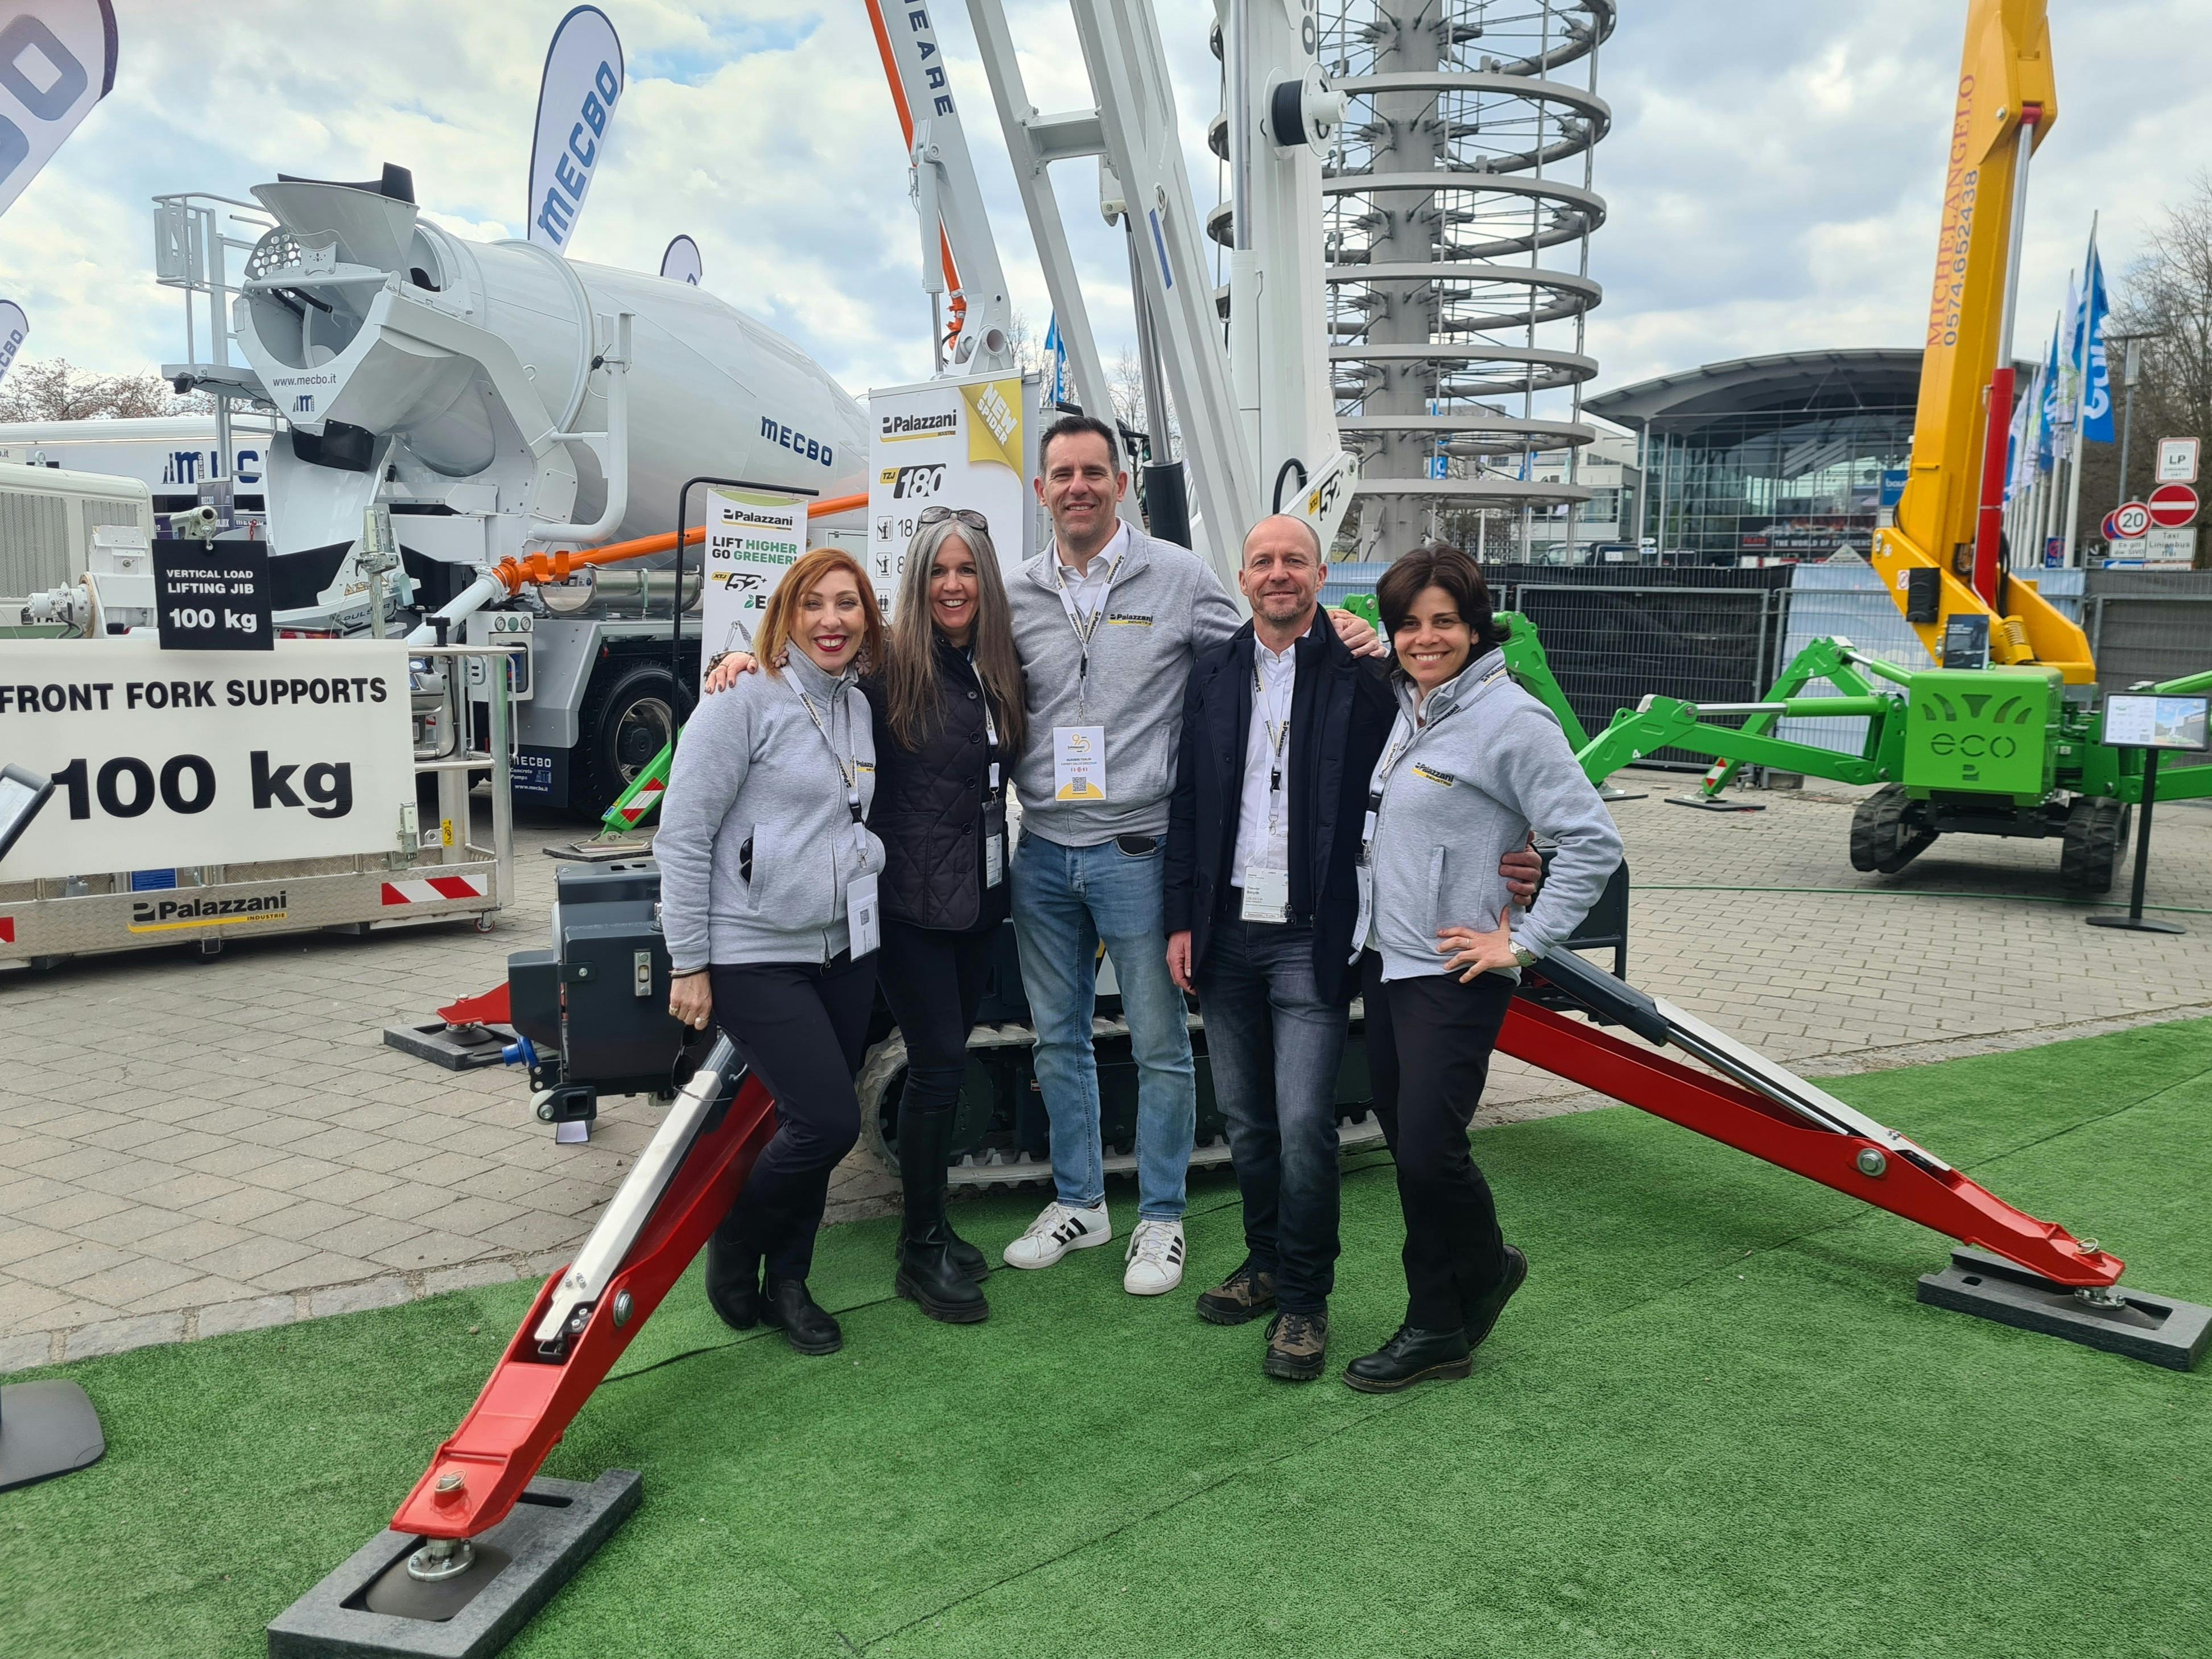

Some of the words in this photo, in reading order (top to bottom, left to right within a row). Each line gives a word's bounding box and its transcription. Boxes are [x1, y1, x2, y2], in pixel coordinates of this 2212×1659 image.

[905, 0, 954, 117] EARE
[538, 60, 618, 245] MECBO
[1926, 75, 1975, 348] MICHELANGELO
[1944, 170, 1978, 346] 0574.652438
[273, 373, 337, 386] www.mecbo.it
[983, 382, 1018, 434] NEW
[894, 409, 957, 432] Palazzani
[976, 398, 1009, 446] SPIDER
[761, 415, 833, 467] MECBO
[2169, 455, 2186, 465] LP
[882, 472, 895, 480] TZJ
[899, 465, 946, 498] 180
[734, 510, 793, 526] Palazzani
[898, 519, 913, 538] 18
[2122, 513, 2144, 527] 20
[712, 536, 743, 548] LIFT
[745, 539, 797, 554] HIGHER
[712, 548, 731, 559] GO
[166, 569, 220, 579] VERTICAL
[224, 570, 254, 579] LOAD
[167, 582, 226, 595] LIFTING
[230, 581, 255, 595] JIB
[170, 609, 215, 629] 100
[226, 609, 257, 633] kg
[1117, 613, 1153, 622] Palazzani
[1808, 668, 1815, 677] 2
[0, 683, 114, 715] FRONT
[127, 680, 217, 709] FORK
[226, 676, 388, 706] SUPPORTS
[1632, 748, 1642, 759] 4
[1930, 733, 2016, 758] eco
[51, 753, 217, 821] 100
[250, 750, 353, 819] kg
[159, 890, 287, 920] Palazzani
[247, 913, 286, 921] INDUSTRIE
